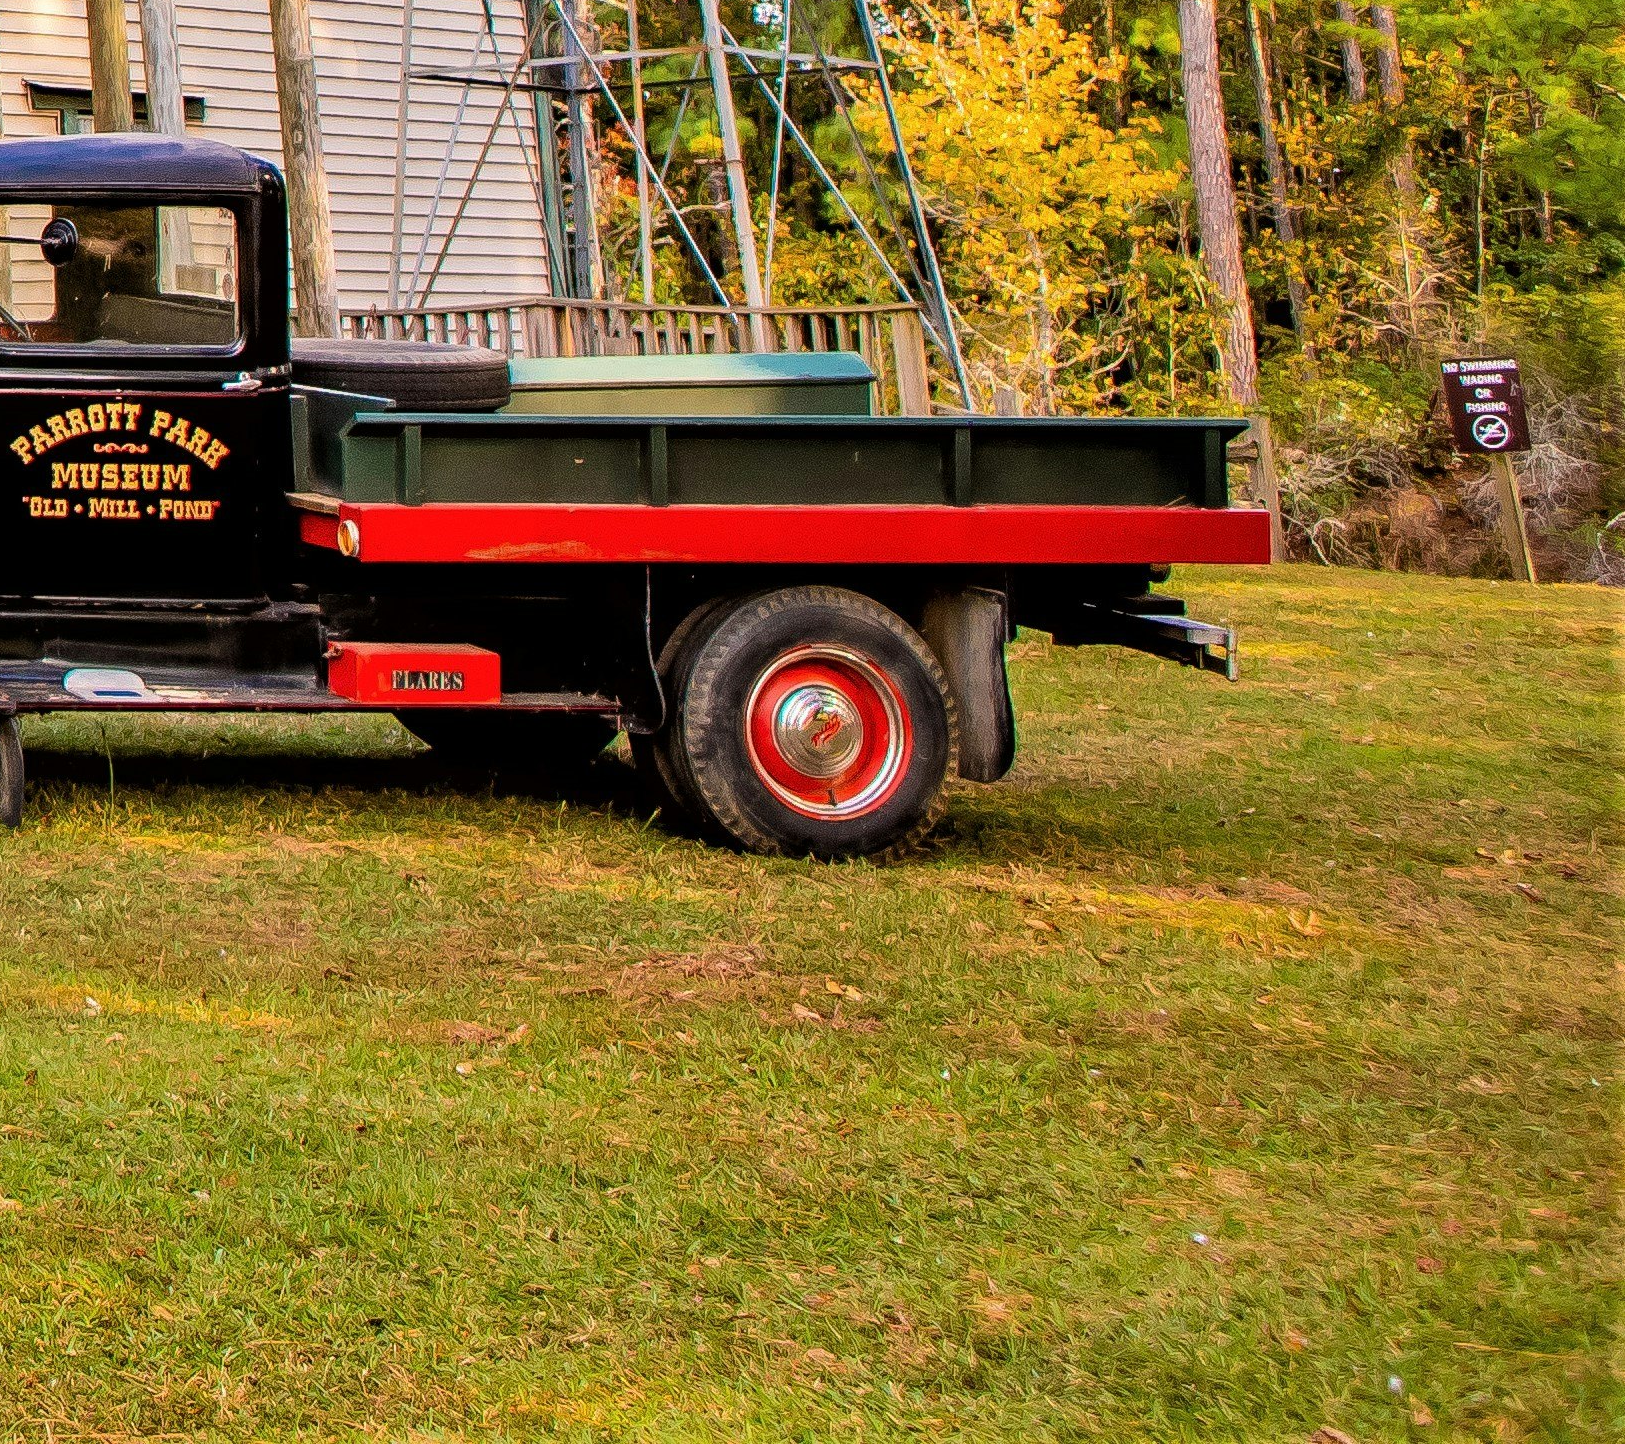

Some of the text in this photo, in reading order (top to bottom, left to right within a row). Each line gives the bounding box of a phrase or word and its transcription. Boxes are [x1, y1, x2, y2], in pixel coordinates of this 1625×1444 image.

[1441, 359, 1518, 373] NO SWIMMING
[1459, 374, 1505, 386] WADING
[1474, 388, 1494, 399] OR
[1464, 402, 1508, 413] FISHING
[10, 403, 230, 470] PARROTT PARK
[51, 462, 190, 491] MUSEUM
[88, 498, 141, 519] MILL
[391, 670, 465, 691] FLARES
